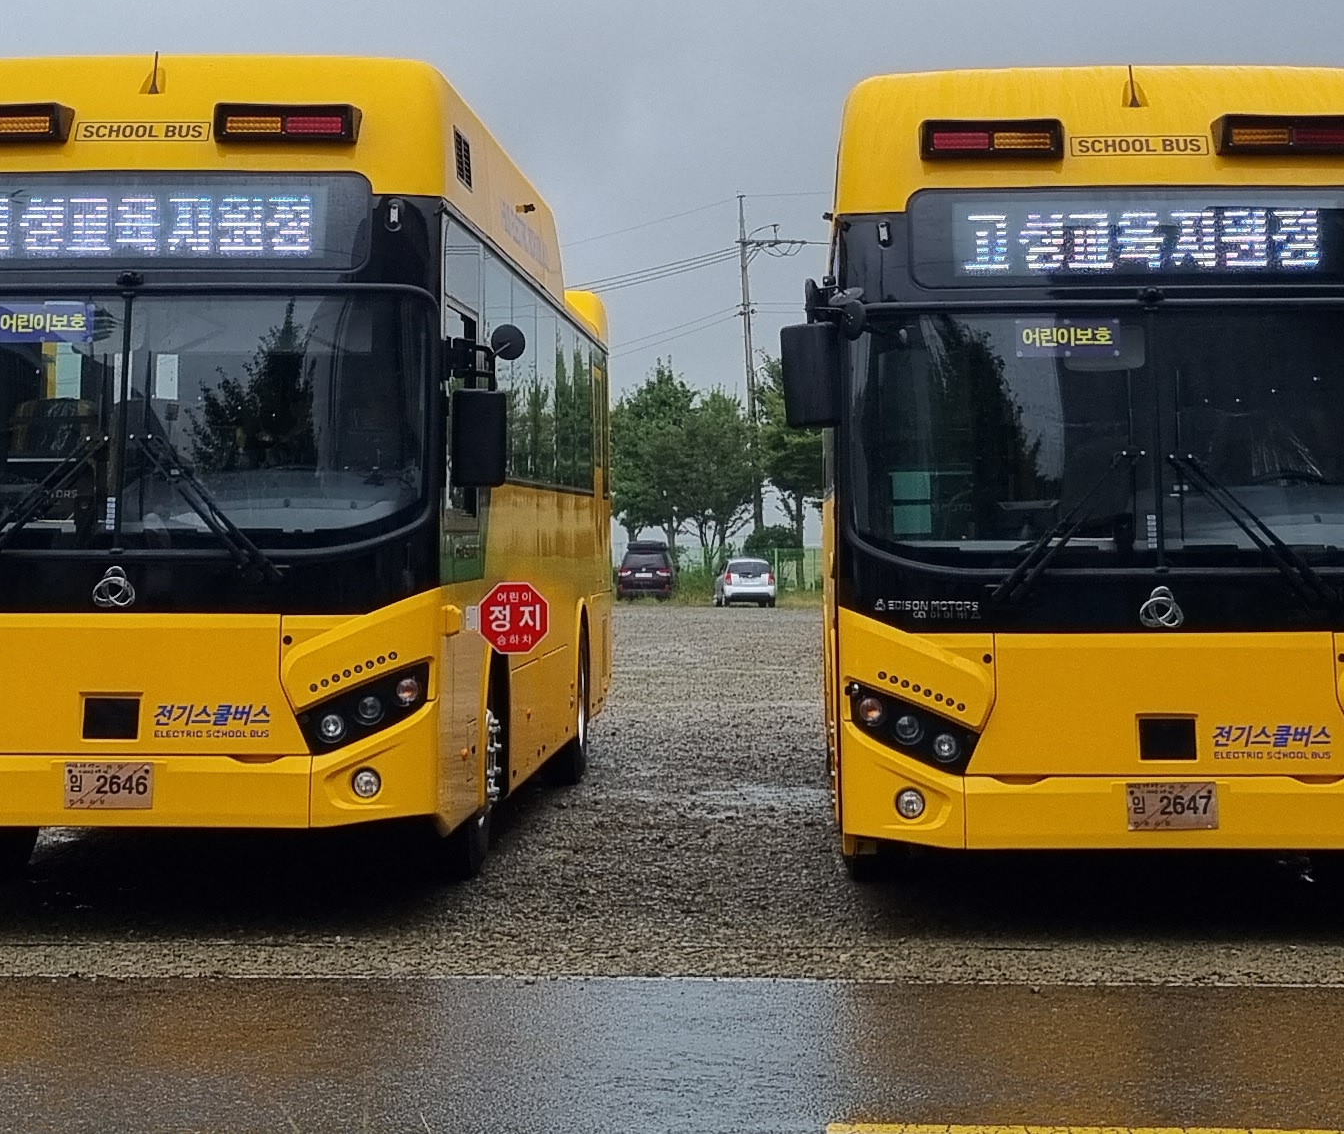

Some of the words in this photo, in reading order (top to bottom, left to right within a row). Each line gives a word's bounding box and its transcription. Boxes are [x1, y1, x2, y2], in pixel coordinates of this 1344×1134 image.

[82, 125, 159, 138] SCHOOL
[163, 125, 203, 138] BUS
[1078, 139, 1157, 153] SCHOOL
[1161, 138, 1201, 152] BUS
[0, 313, 87, 333] 어린이보호
[1022, 327, 1113, 347] 어린이보호
[497, 591, 532, 603] 어린이
[888, 601, 928, 611] EDISON
[931, 601, 979, 611] MOTORS
[489, 604, 541, 632] 정지
[154, 704, 271, 726] 전기스쿨버스
[154, 729, 203, 738] ELECTRIC
[206, 729, 247, 739] SCHOOL
[249, 729, 270, 738] BUS
[1212, 725, 1331, 747] 전기스쿨버스
[1213, 751, 1264, 760] ELECTRIC
[1267, 751, 1308, 760] SCHOOL
[1311, 751, 1332, 760] BUS
[70, 775, 82, 793] 임
[95, 775, 148, 795] 2646
[1132, 796, 1146, 815] 임
[1159, 795, 1212, 815] 2647
